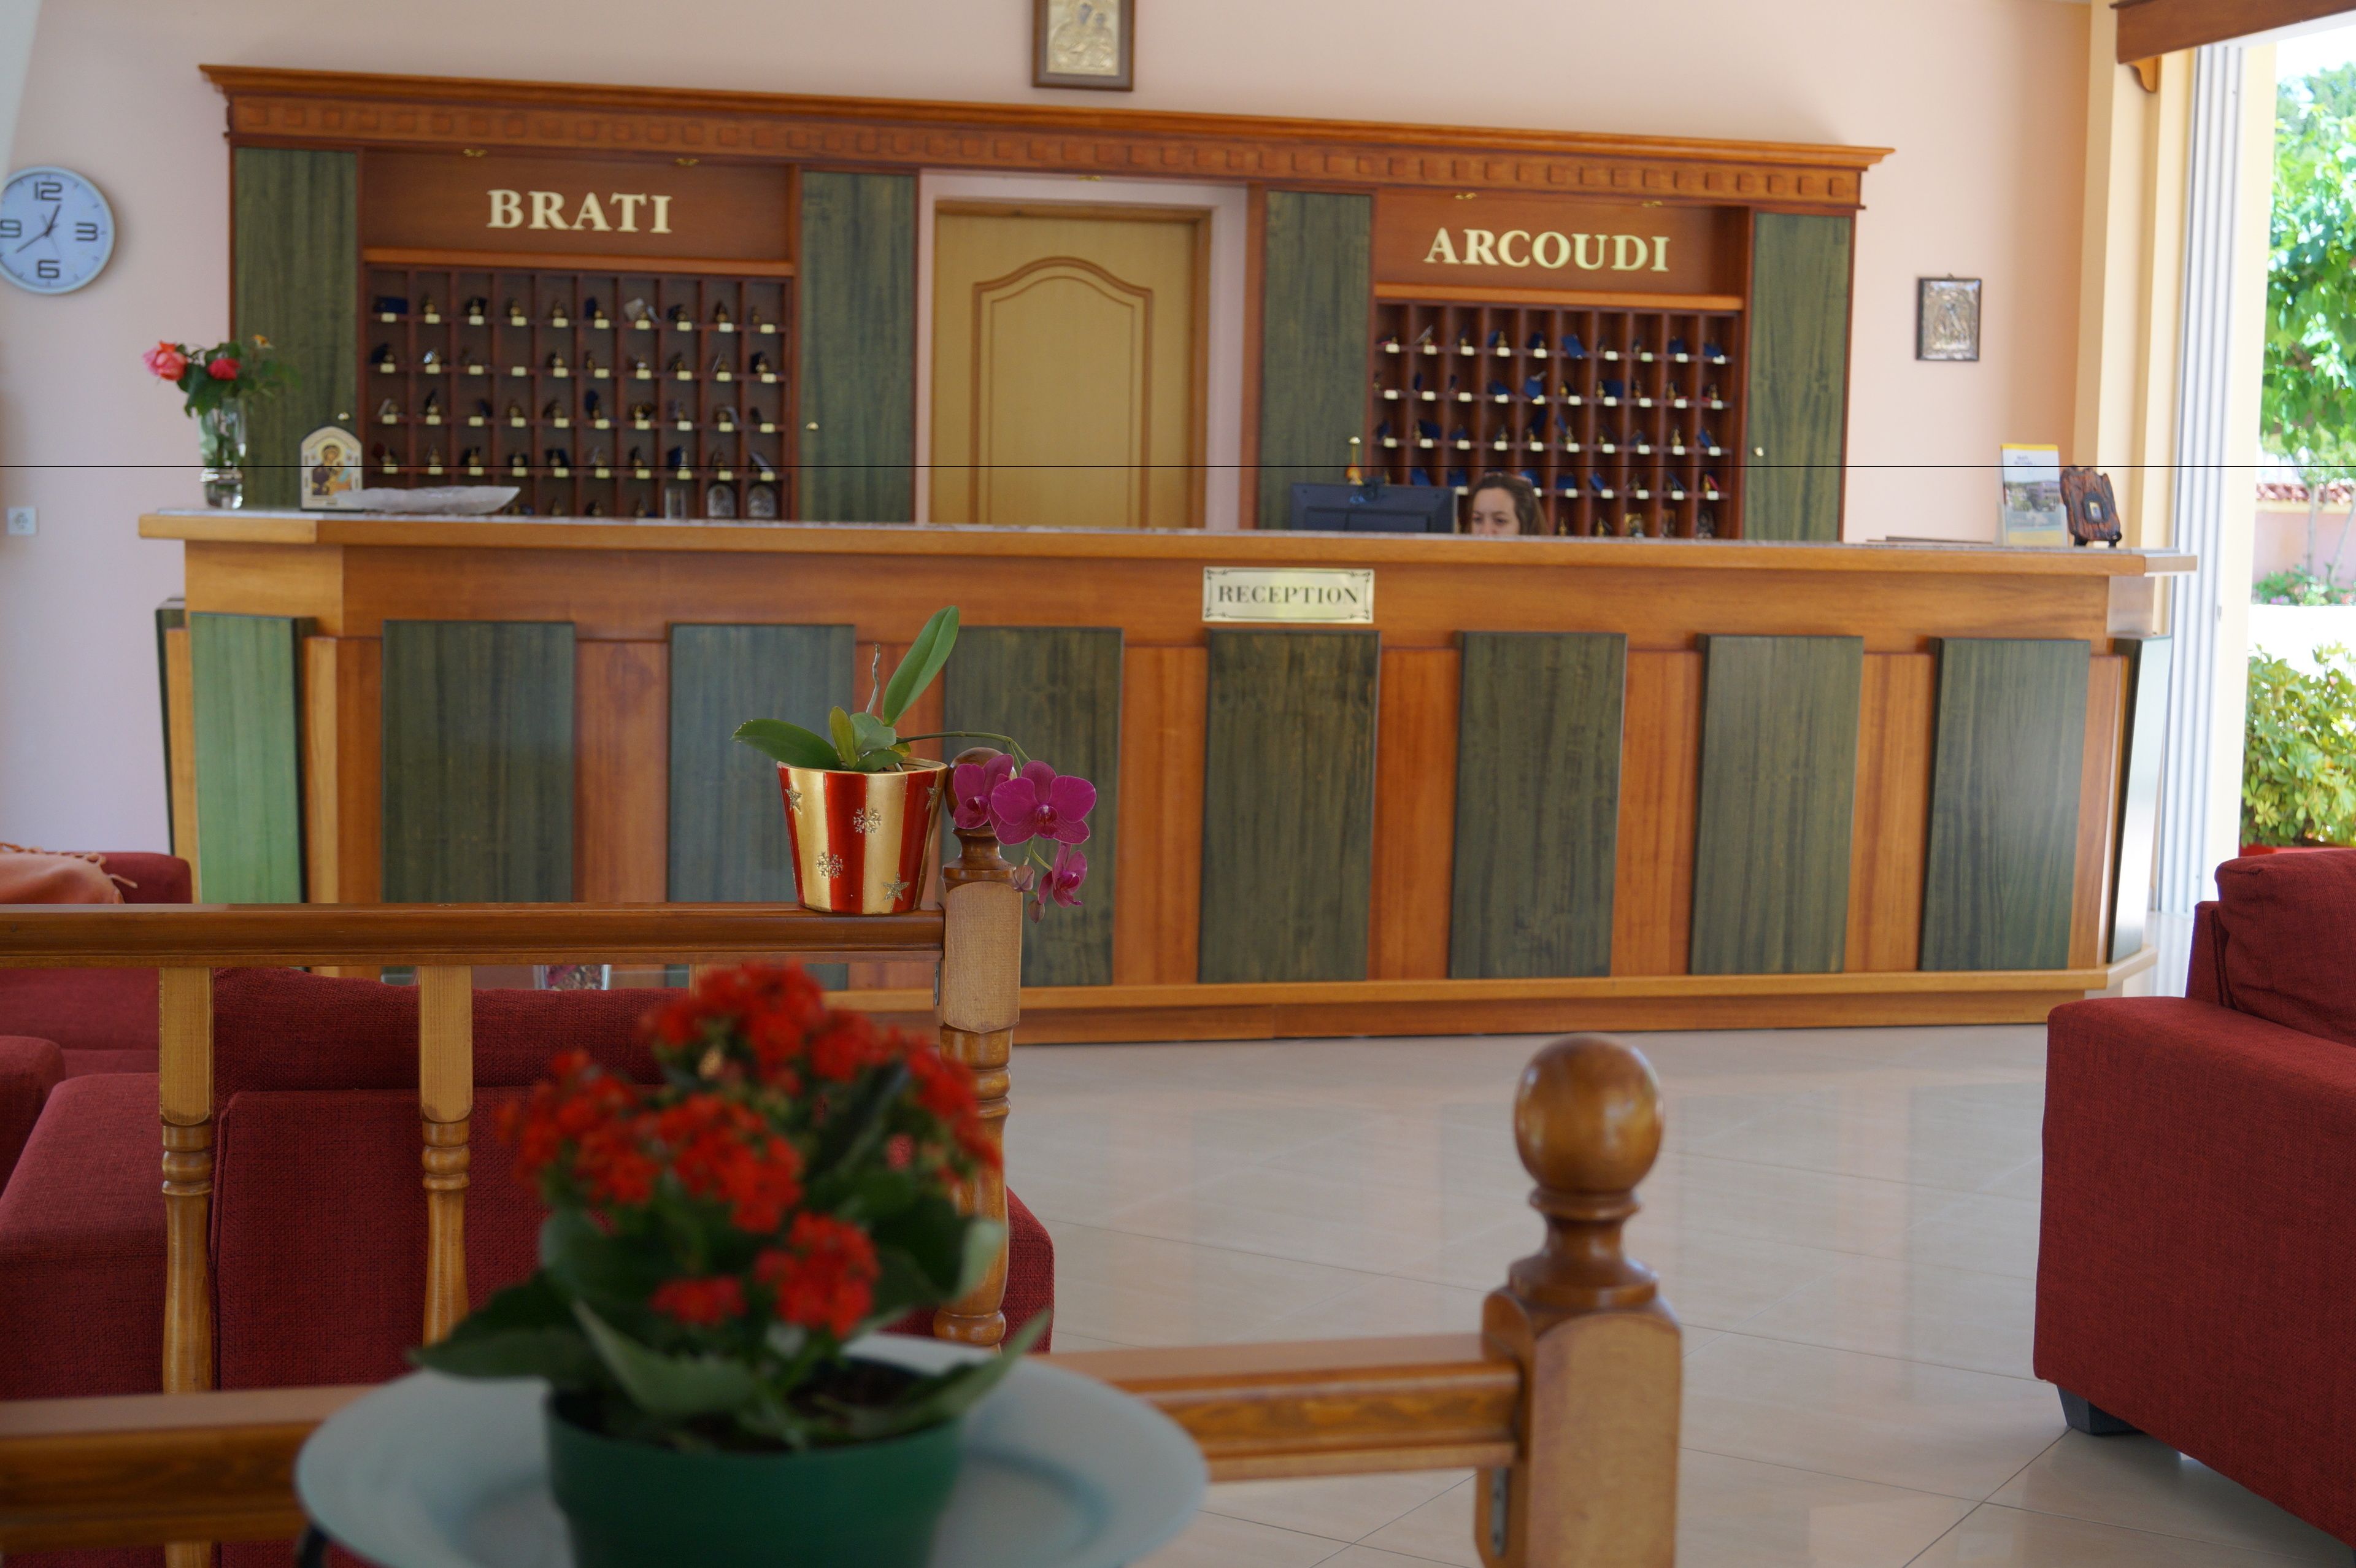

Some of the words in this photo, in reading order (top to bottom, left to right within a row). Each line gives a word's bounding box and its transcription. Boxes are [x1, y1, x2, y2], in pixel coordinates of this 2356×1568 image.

[34, 182, 63, 201] 12
[486, 189, 672, 234] BRATI
[0, 219, 22, 238] 9
[75, 222, 98, 241] 3
[1423, 227, 1670, 272] ARCOUDI
[37, 259, 60, 279] 6
[1218, 585, 1358, 604] RECEPTION
